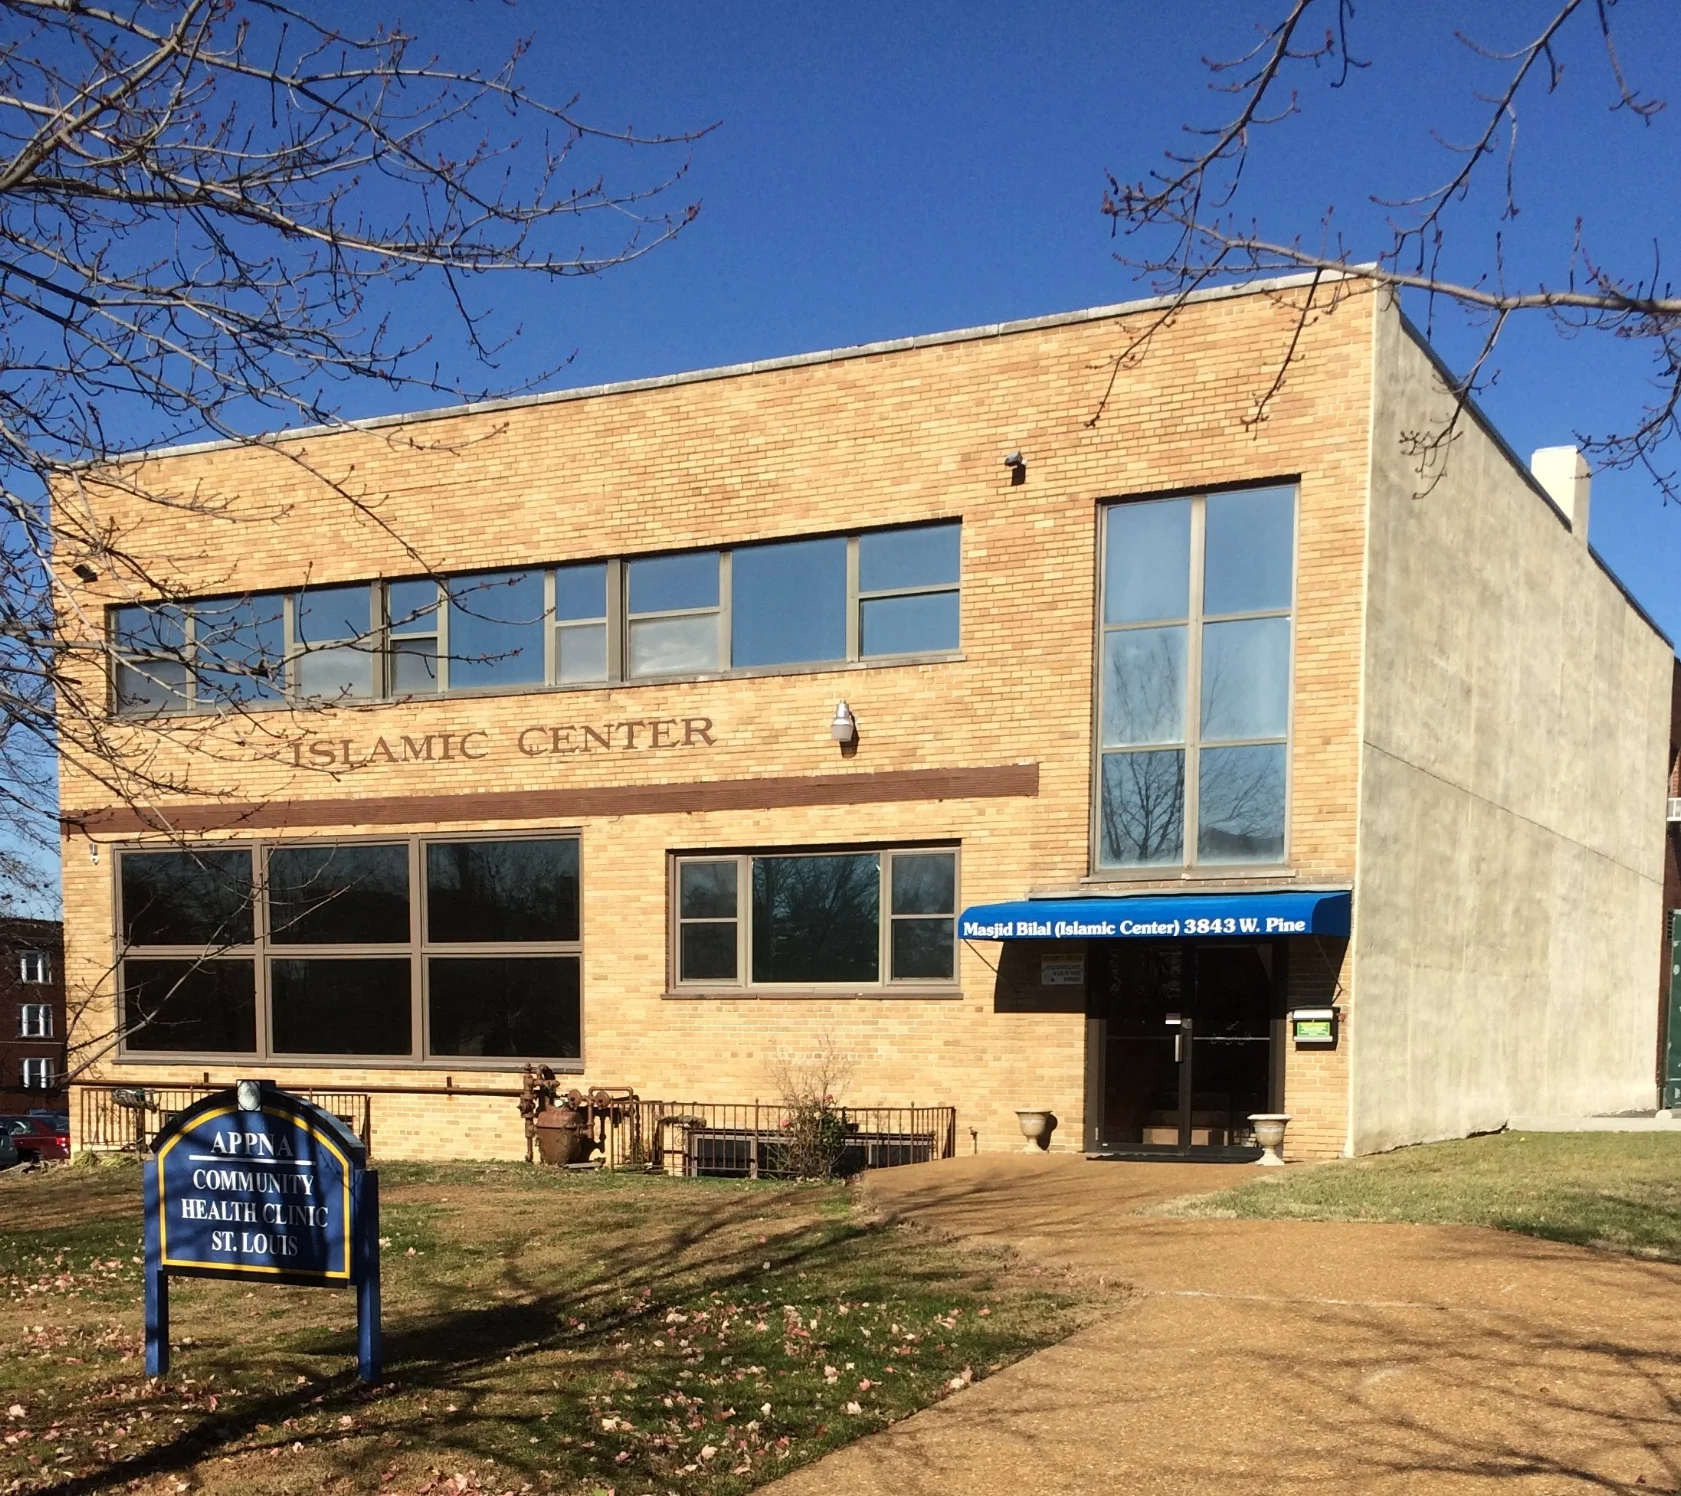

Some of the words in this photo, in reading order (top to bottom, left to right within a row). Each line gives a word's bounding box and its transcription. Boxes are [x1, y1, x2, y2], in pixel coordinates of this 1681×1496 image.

[293, 730, 489, 768] ISLAMIC
[517, 717, 718, 757] CENTER
[963, 921, 1013, 939] Masjid
[1016, 921, 1052, 937] Bilal
[1054, 920, 1116, 939] (Islamic
[1119, 919, 1181, 938] Center)
[1184, 918, 1237, 934] 3843
[1238, 918, 1261, 933] W.
[1265, 917, 1306, 933] Pine
[210, 1131, 294, 1157] APPNA
[192, 1168, 314, 1196] COMMUNITY
[181, 1198, 258, 1223] HEALTH
[262, 1203, 329, 1228] CLINIC
[211, 1230, 238, 1252] ST.
[241, 1232, 299, 1257] LOUIS
